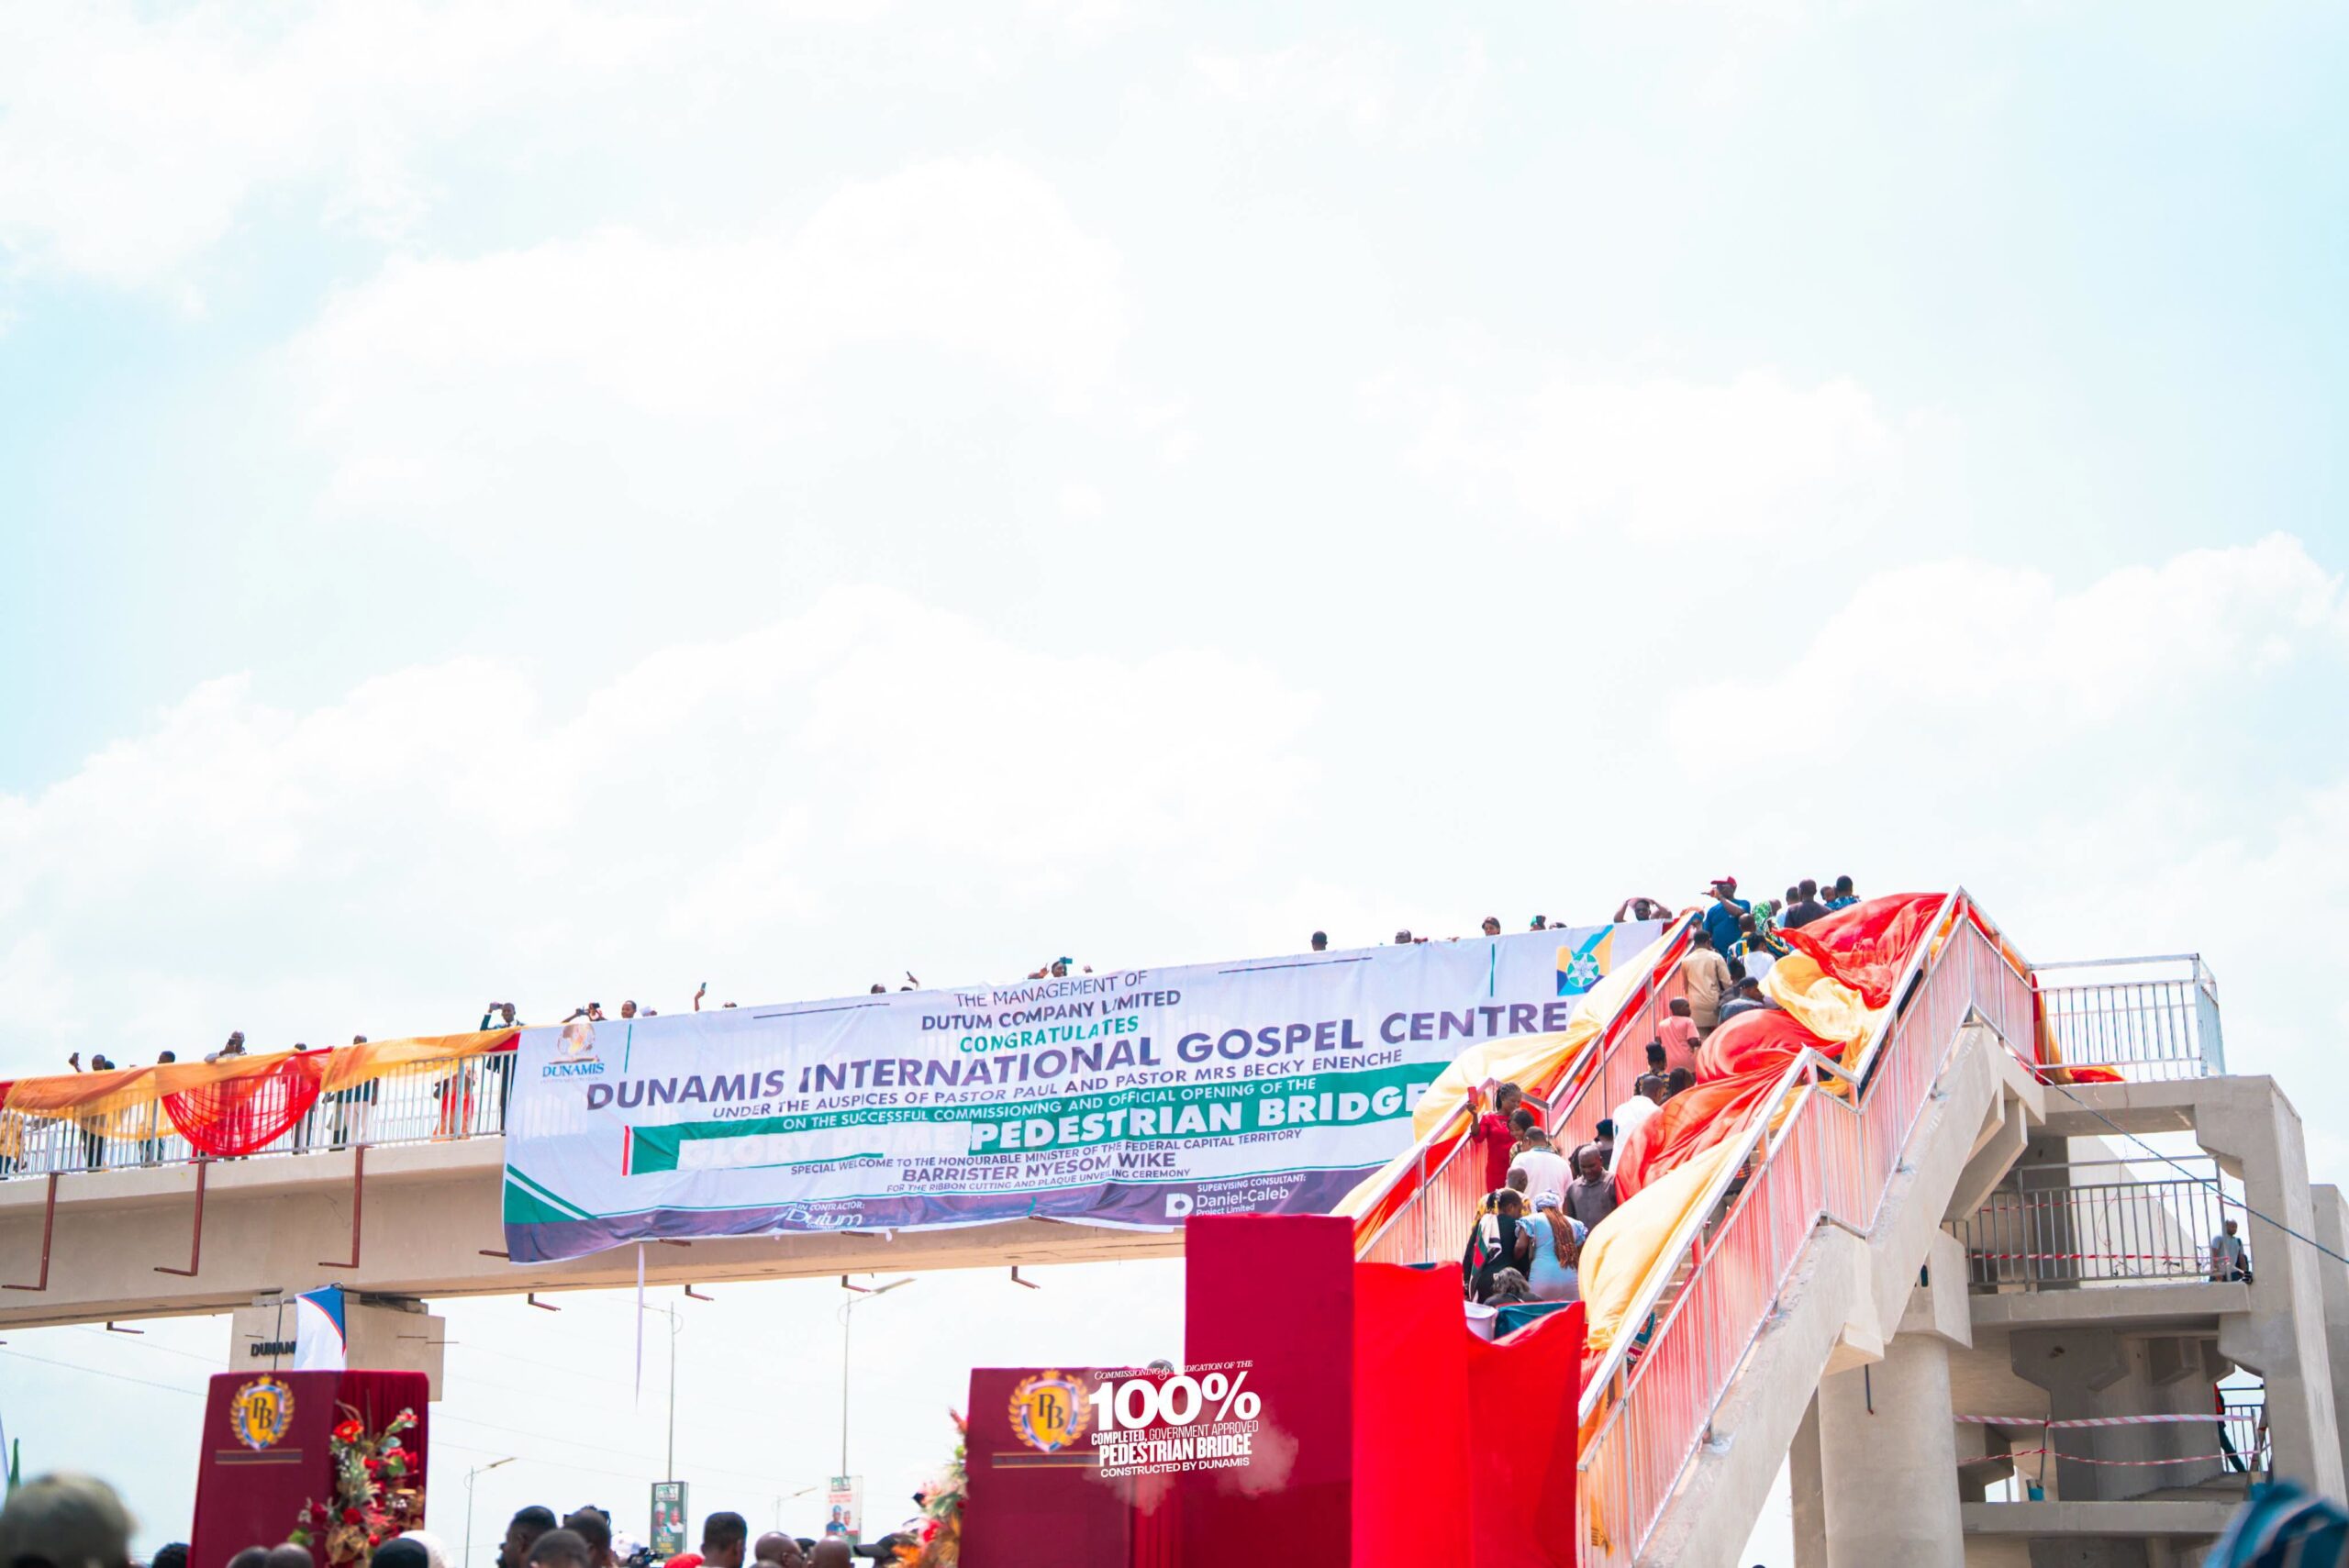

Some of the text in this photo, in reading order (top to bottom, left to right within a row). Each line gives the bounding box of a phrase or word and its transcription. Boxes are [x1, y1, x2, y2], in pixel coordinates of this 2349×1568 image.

[954, 970, 1148, 1007] THE MANAGEMENT OF
[921, 990, 1181, 1030] DUTUM COMPANY LIMITED
[960, 1016, 1139, 1052] CONGRATULATES
[542, 1062, 605, 1078] DUNAMIS
[587, 1002, 1567, 1110] DUNAMIS INTERNATIONAL GOSPEL CENTRE
[713, 1050, 1402, 1118] UNDER THE AUSPICES OF PASTOR PAUL AND PASTOR MRS BECKY ENENCHE
[783, 1077, 1317, 1129] ON THE SUCCESSFUL COMMISSIONING AND OFFICIAL OPENING OF THE
[971, 1102, 1242, 1150] PEDESTRIAN
[791, 1129, 1302, 1175] SPECIAL WELCOME TO THE HONOURABLE MINISTER OF THE FEDERAL CAPITAL TERRITORY
[902, 1152, 1176, 1182] BARRISTER NYESOM WIKE
[887, 1168, 1191, 1193] FOR THE RIBBON CUTTING AND PLAQUE UNVEILING CEREMONY
[1197, 1173, 1307, 1193] SUPERVISING CONSULTANT:
[809, 1201, 865, 1211] CONTRACTOR:
[1197, 1187, 1289, 1208] Daniel-Caleb
[1226, 1204, 1255, 1214] Limited
[785, 1208, 863, 1226] Dutum
